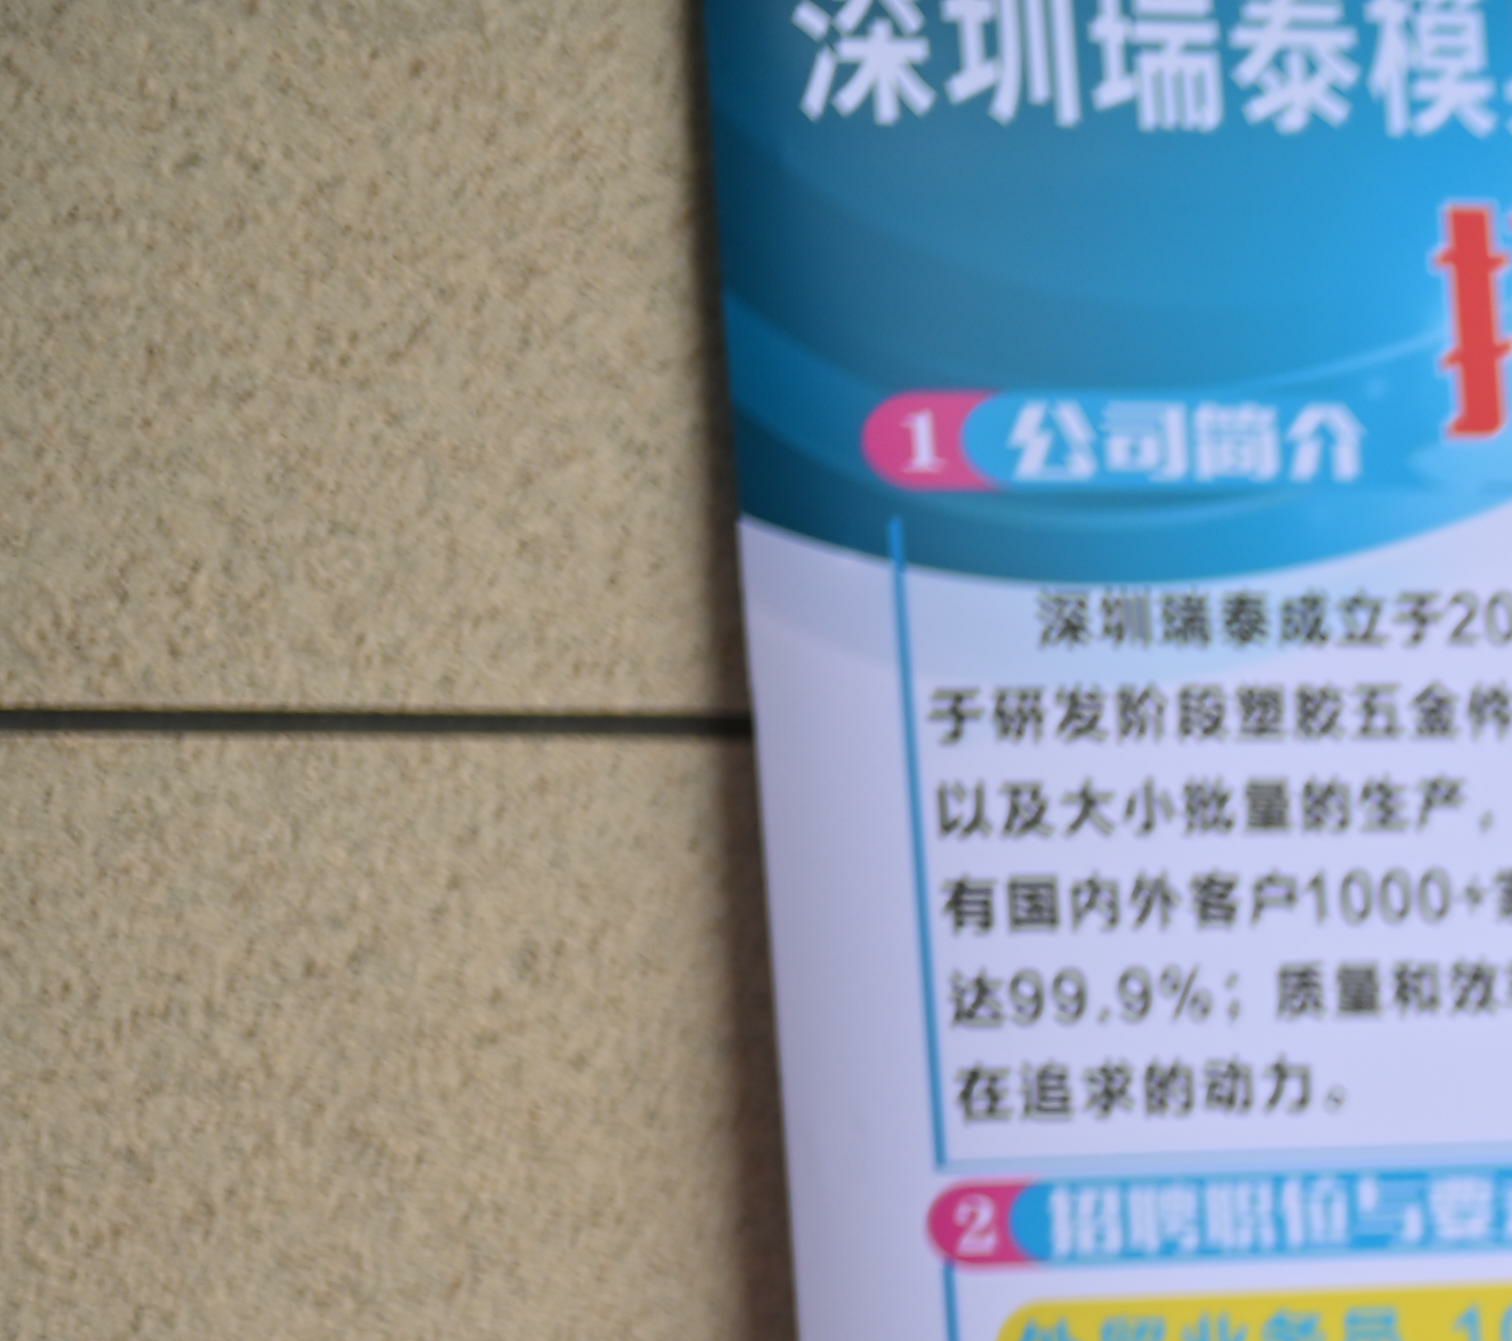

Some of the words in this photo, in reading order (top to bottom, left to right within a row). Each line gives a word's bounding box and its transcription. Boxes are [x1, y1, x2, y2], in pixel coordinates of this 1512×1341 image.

[898, 412, 947, 471] 1
[1005, 395, 1368, 485] 公司简介
[952, 1201, 997, 1259] 2
